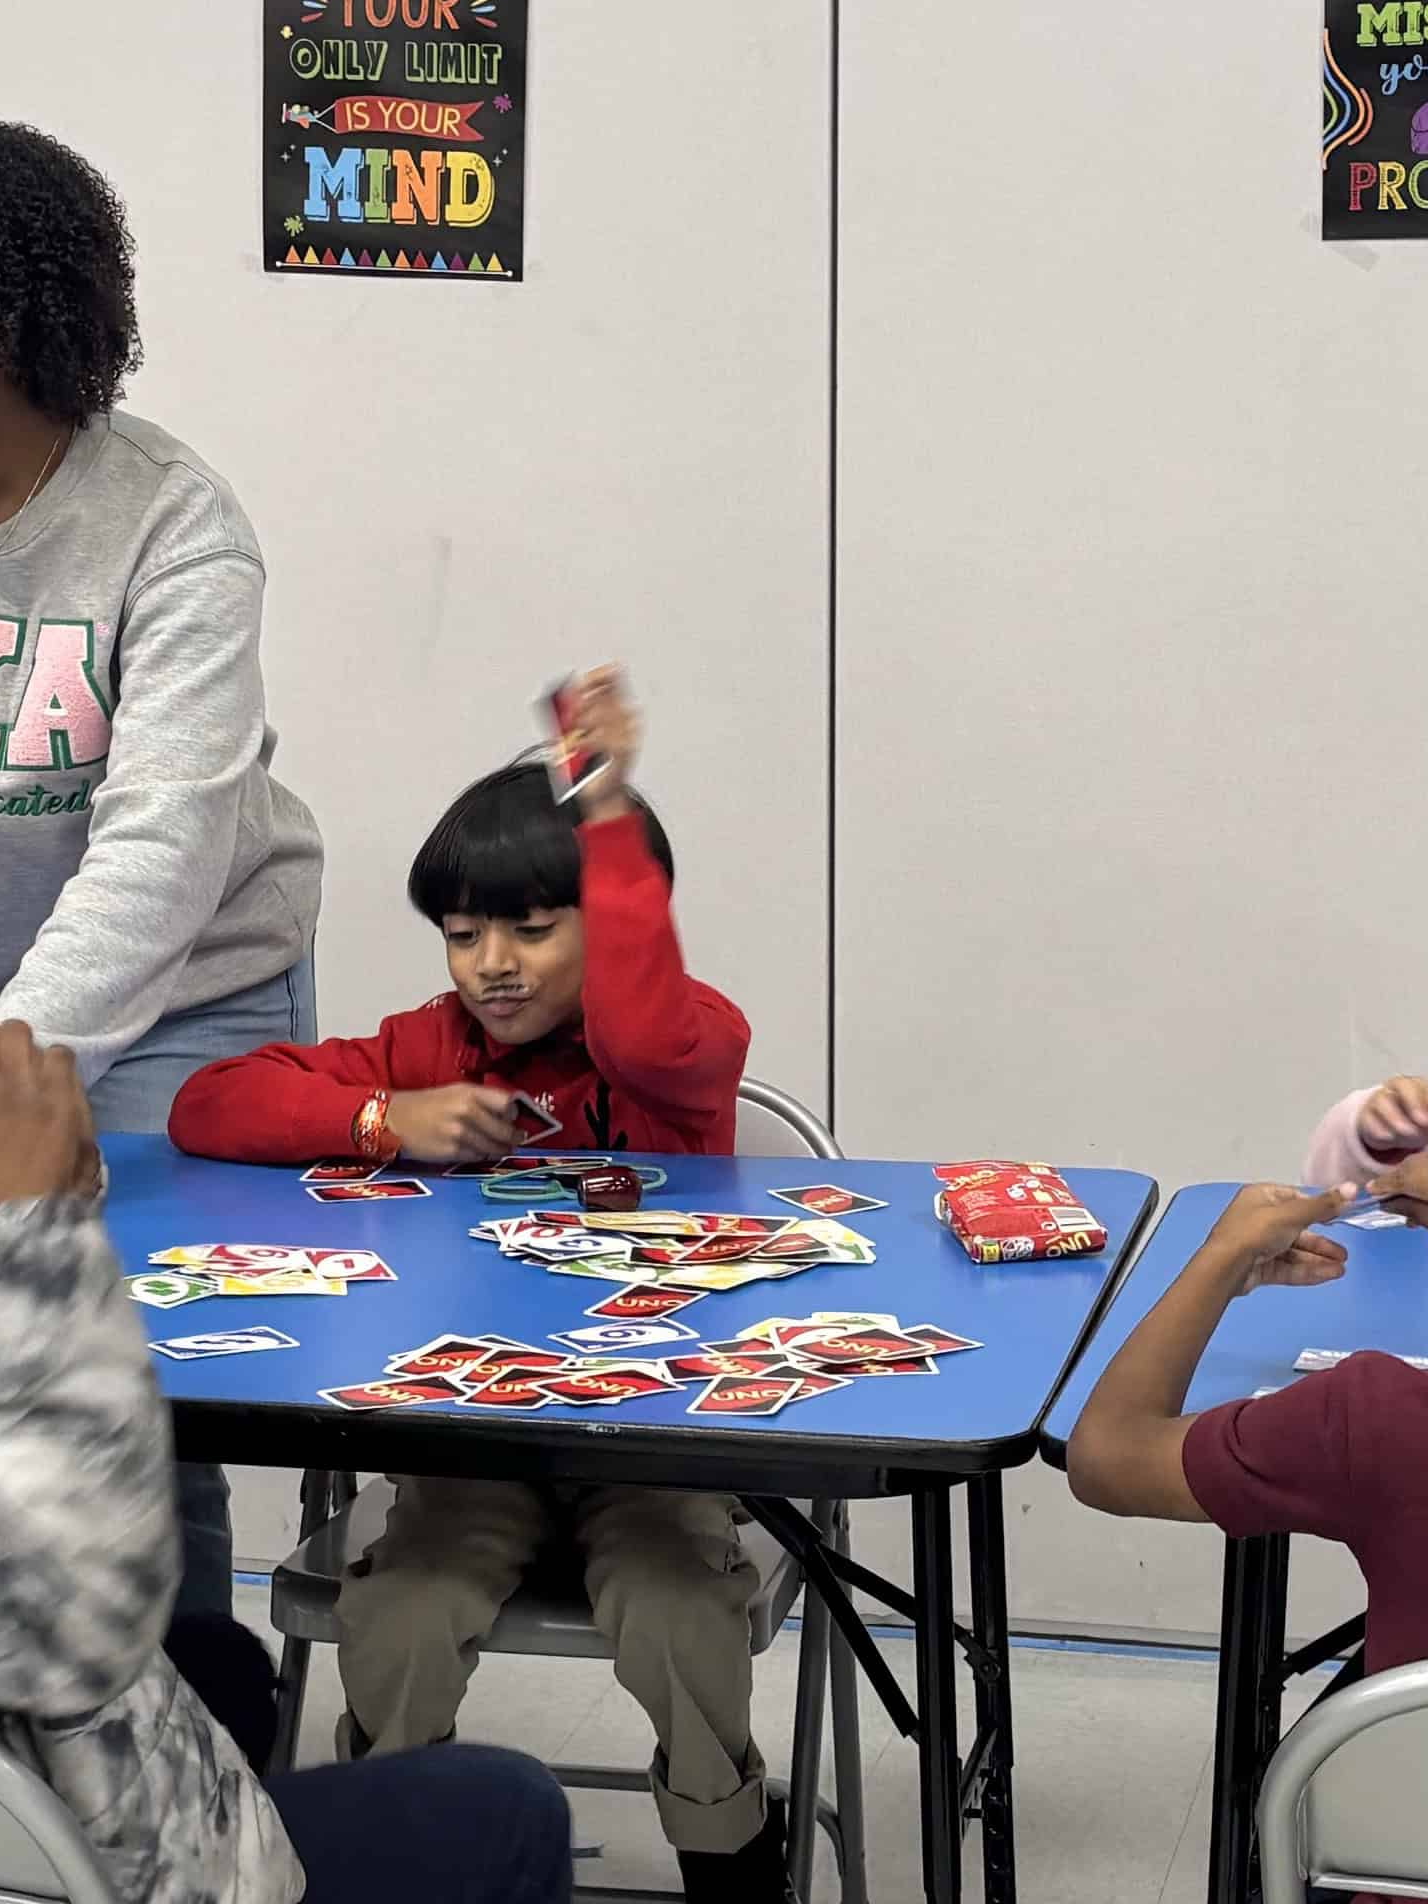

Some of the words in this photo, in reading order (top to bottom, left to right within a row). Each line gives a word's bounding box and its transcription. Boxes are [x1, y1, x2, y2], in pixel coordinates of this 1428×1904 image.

[289, 38, 388, 81] ONLY
[405, 40, 503, 84] LIMIT
[344, 100, 370, 131] IS
[378, 100, 462, 137] YOUR
[303, 145, 496, 228] MIND
[1046, 1231, 1092, 1258] UNO
[570, 1375, 638, 1396] UNO
[710, 1389, 785, 1403] UNO
